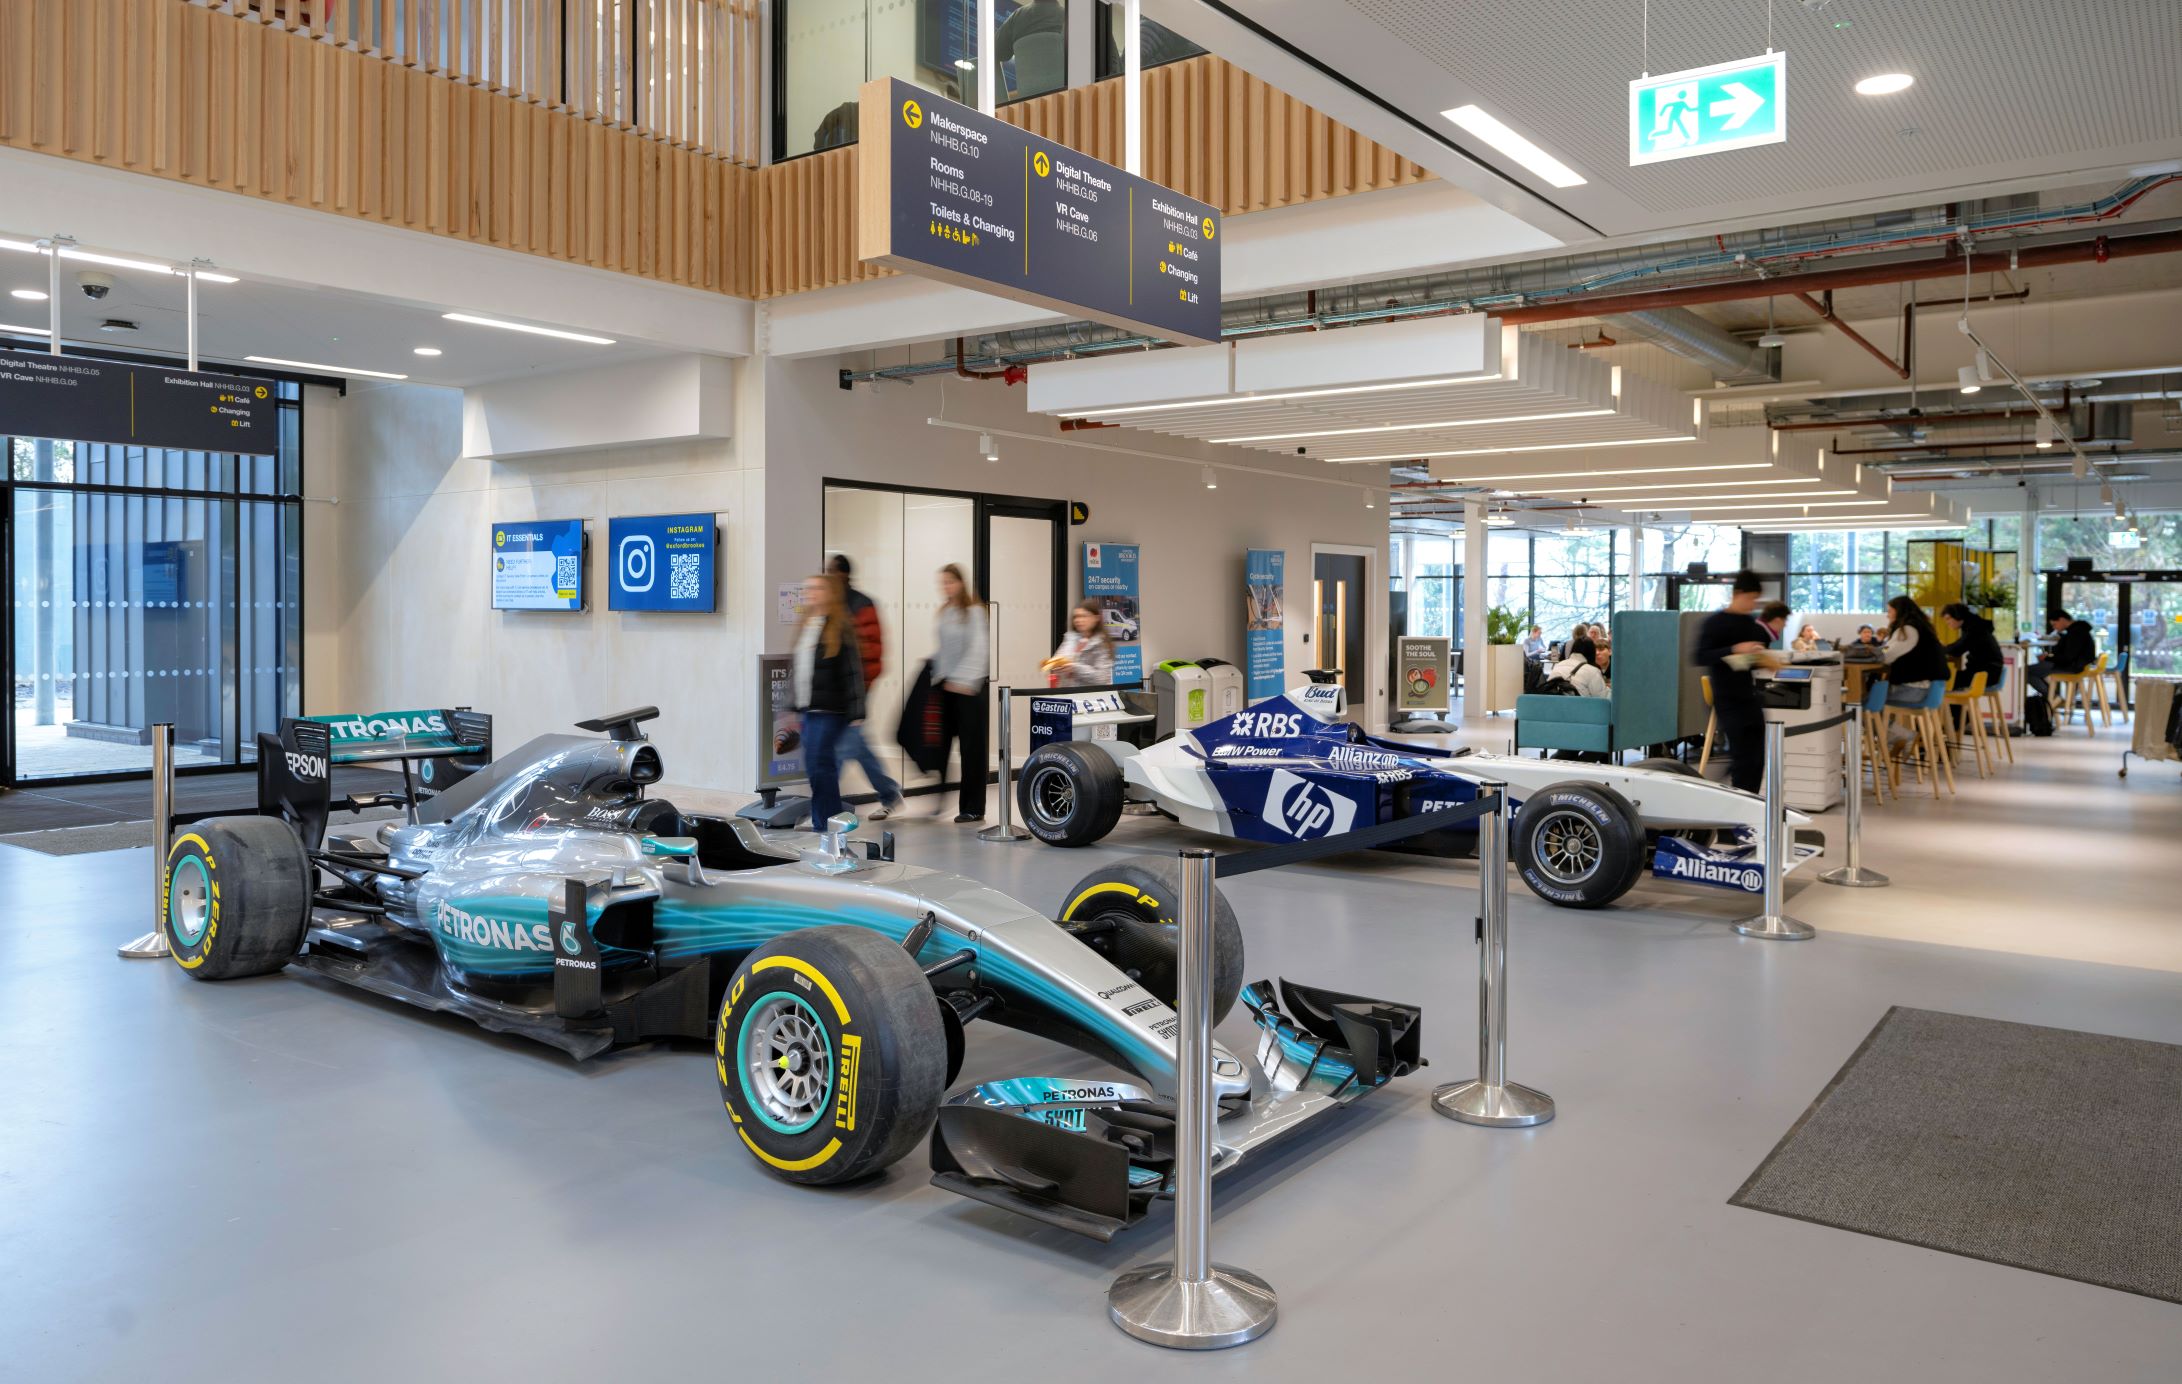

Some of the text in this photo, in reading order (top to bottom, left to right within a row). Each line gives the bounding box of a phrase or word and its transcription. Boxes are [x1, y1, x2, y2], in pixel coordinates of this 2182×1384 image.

[930, 111, 988, 145] Makerspace
[930, 130, 980, 159] NHHB.G.10
[930, 157, 965, 180] Rooms
[1056, 161, 1112, 192] Digital Theatre
[930, 175, 993, 207] NHHB.G.08-19
[1056, 178, 1098, 203] NHHB.G.05
[930, 202, 1015, 242] Toilets & Changing
[1056, 201, 1089, 223] VR Cave
[1152, 199, 1198, 226] Exhibition Hall
[1056, 218, 1098, 242] NHHB.G.06
[1163, 218, 1198, 240] NHHB.G.03
[1183, 246, 1198, 261] Café
[1167, 263, 1198, 284] Changing
[1187, 291, 1198, 305] Lift
[0, 358, 100, 376] Digital Theatre NHHB.G.05
[0, 372, 77, 387] VR Cave NHHB.G.06
[164, 377, 199, 388] Exhibition
[200, 379, 214, 389] Hall
[234, 396, 250, 404] Café
[218, 407, 250, 418] Changing
[239, 420, 251, 428] Lift
[506, 533, 544, 543] IT ESSENTIALS
[667, 525, 704, 534] INSTAGRAM
[1100, 576, 1121, 585] security
[1305, 686, 1337, 699] Bud
[1040, 702, 1068, 713] Castrol
[330, 715, 447, 739] TRONAS
[1031, 725, 1053, 736] ORIS
[1254, 713, 1303, 738] RBS
[1244, 745, 1283, 757] Power
[1328, 746, 1383, 764] Allianz
[285, 751, 327, 779] EPSON
[1043, 752, 1078, 773] MICHELIN
[1286, 780, 1331, 839] hp
[1558, 794, 1610, 825] MICHELIN
[1672, 856, 1742, 885] Allianz
[203, 879, 221, 956] ZERO
[437, 899, 555, 952] PETRONAS
[555, 957, 597, 970] PETRONAS
[1121, 998, 1162, 1017] PIRELLI
[717, 973, 746, 1088] ZERO
[1149, 1016, 1177, 1031] PETRONA
[835, 1034, 862, 1131] PIRELLI
[1043, 1086, 1115, 1101] PETRONAS
